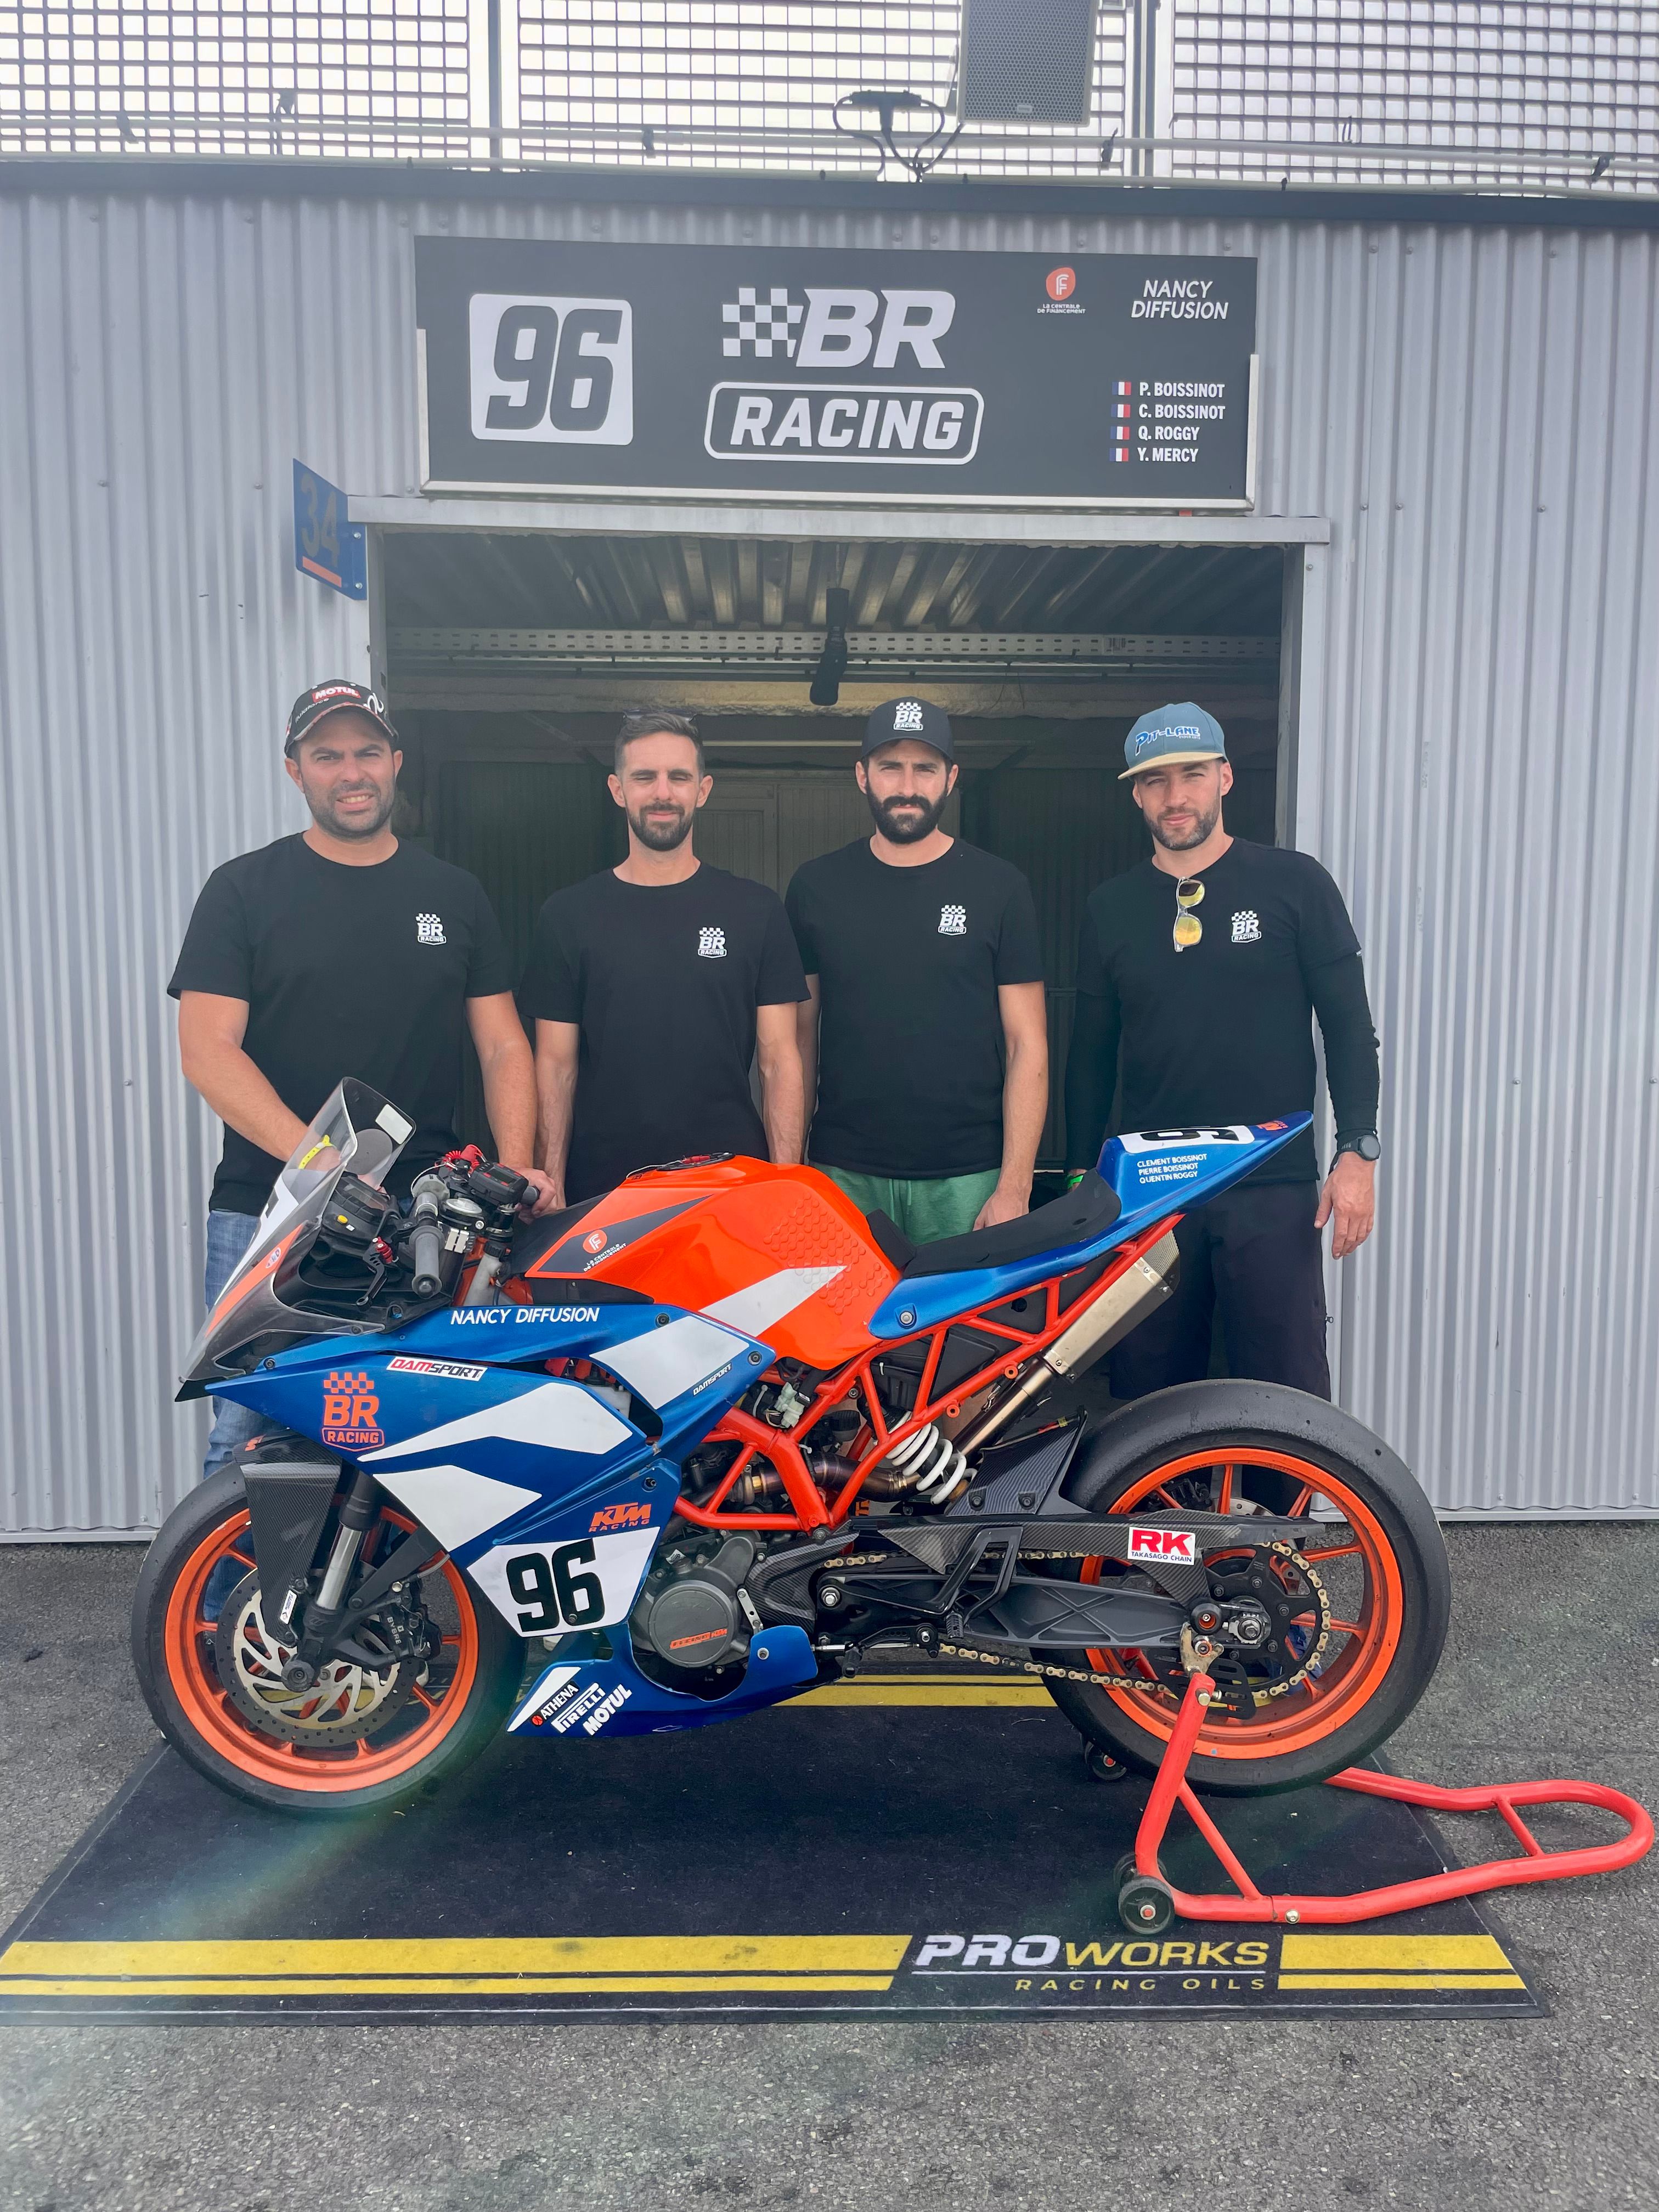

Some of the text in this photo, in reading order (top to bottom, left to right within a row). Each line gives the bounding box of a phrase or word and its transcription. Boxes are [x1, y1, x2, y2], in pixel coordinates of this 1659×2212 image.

[1143, 280, 1213, 298] NANCY
[1131, 301, 1228, 319] DIFFUSION
[796, 289, 956, 368] BR
[485, 305, 623, 432] 96
[1139, 382, 1225, 398] P. BOISSINOT
[1138, 404, 1226, 419] C. BOISSINOT
[730, 396, 964, 450] RACING
[1138, 426, 1200, 441] Q. ROGGY
[1137, 447, 1199, 462] Y. MERCY
[301, 472, 340, 568] 34
[315, 686, 358, 700] MOTUL
[895, 710, 923, 724] BR
[940, 913, 966, 927] BR
[1232, 919, 1259, 935] BR
[417, 923, 443, 936] BR
[1234, 933, 1259, 941] RACING
[699, 936, 726, 949] BR
[1137, 1153, 1207, 1167] CLEMENT BOISSINOT
[1138, 1163, 1198, 1176] PIERRE BOISSINOT
[1139, 1171, 1198, 1184] QUENTIN ROGGY
[450, 1307, 600, 1325] NANCY DIFFUSION
[324, 1395, 380, 1427] BR
[328, 1431, 379, 1444] RACING
[591, 1502, 651, 1526] KTM
[589, 1519, 650, 1532] RACING
[1132, 1529, 1193, 1556] RK
[1131, 1551, 1168, 1560] TAKASAGO
[506, 1538, 605, 1633] 96
[387, 1616, 402, 1645] BYBRE
[540, 1684, 579, 1720] ATHENA
[551, 1683, 606, 1734] PIRELLI
[583, 1684, 632, 1736] MOTUL
[1015, 1978, 1265, 1991] RACING OILS
